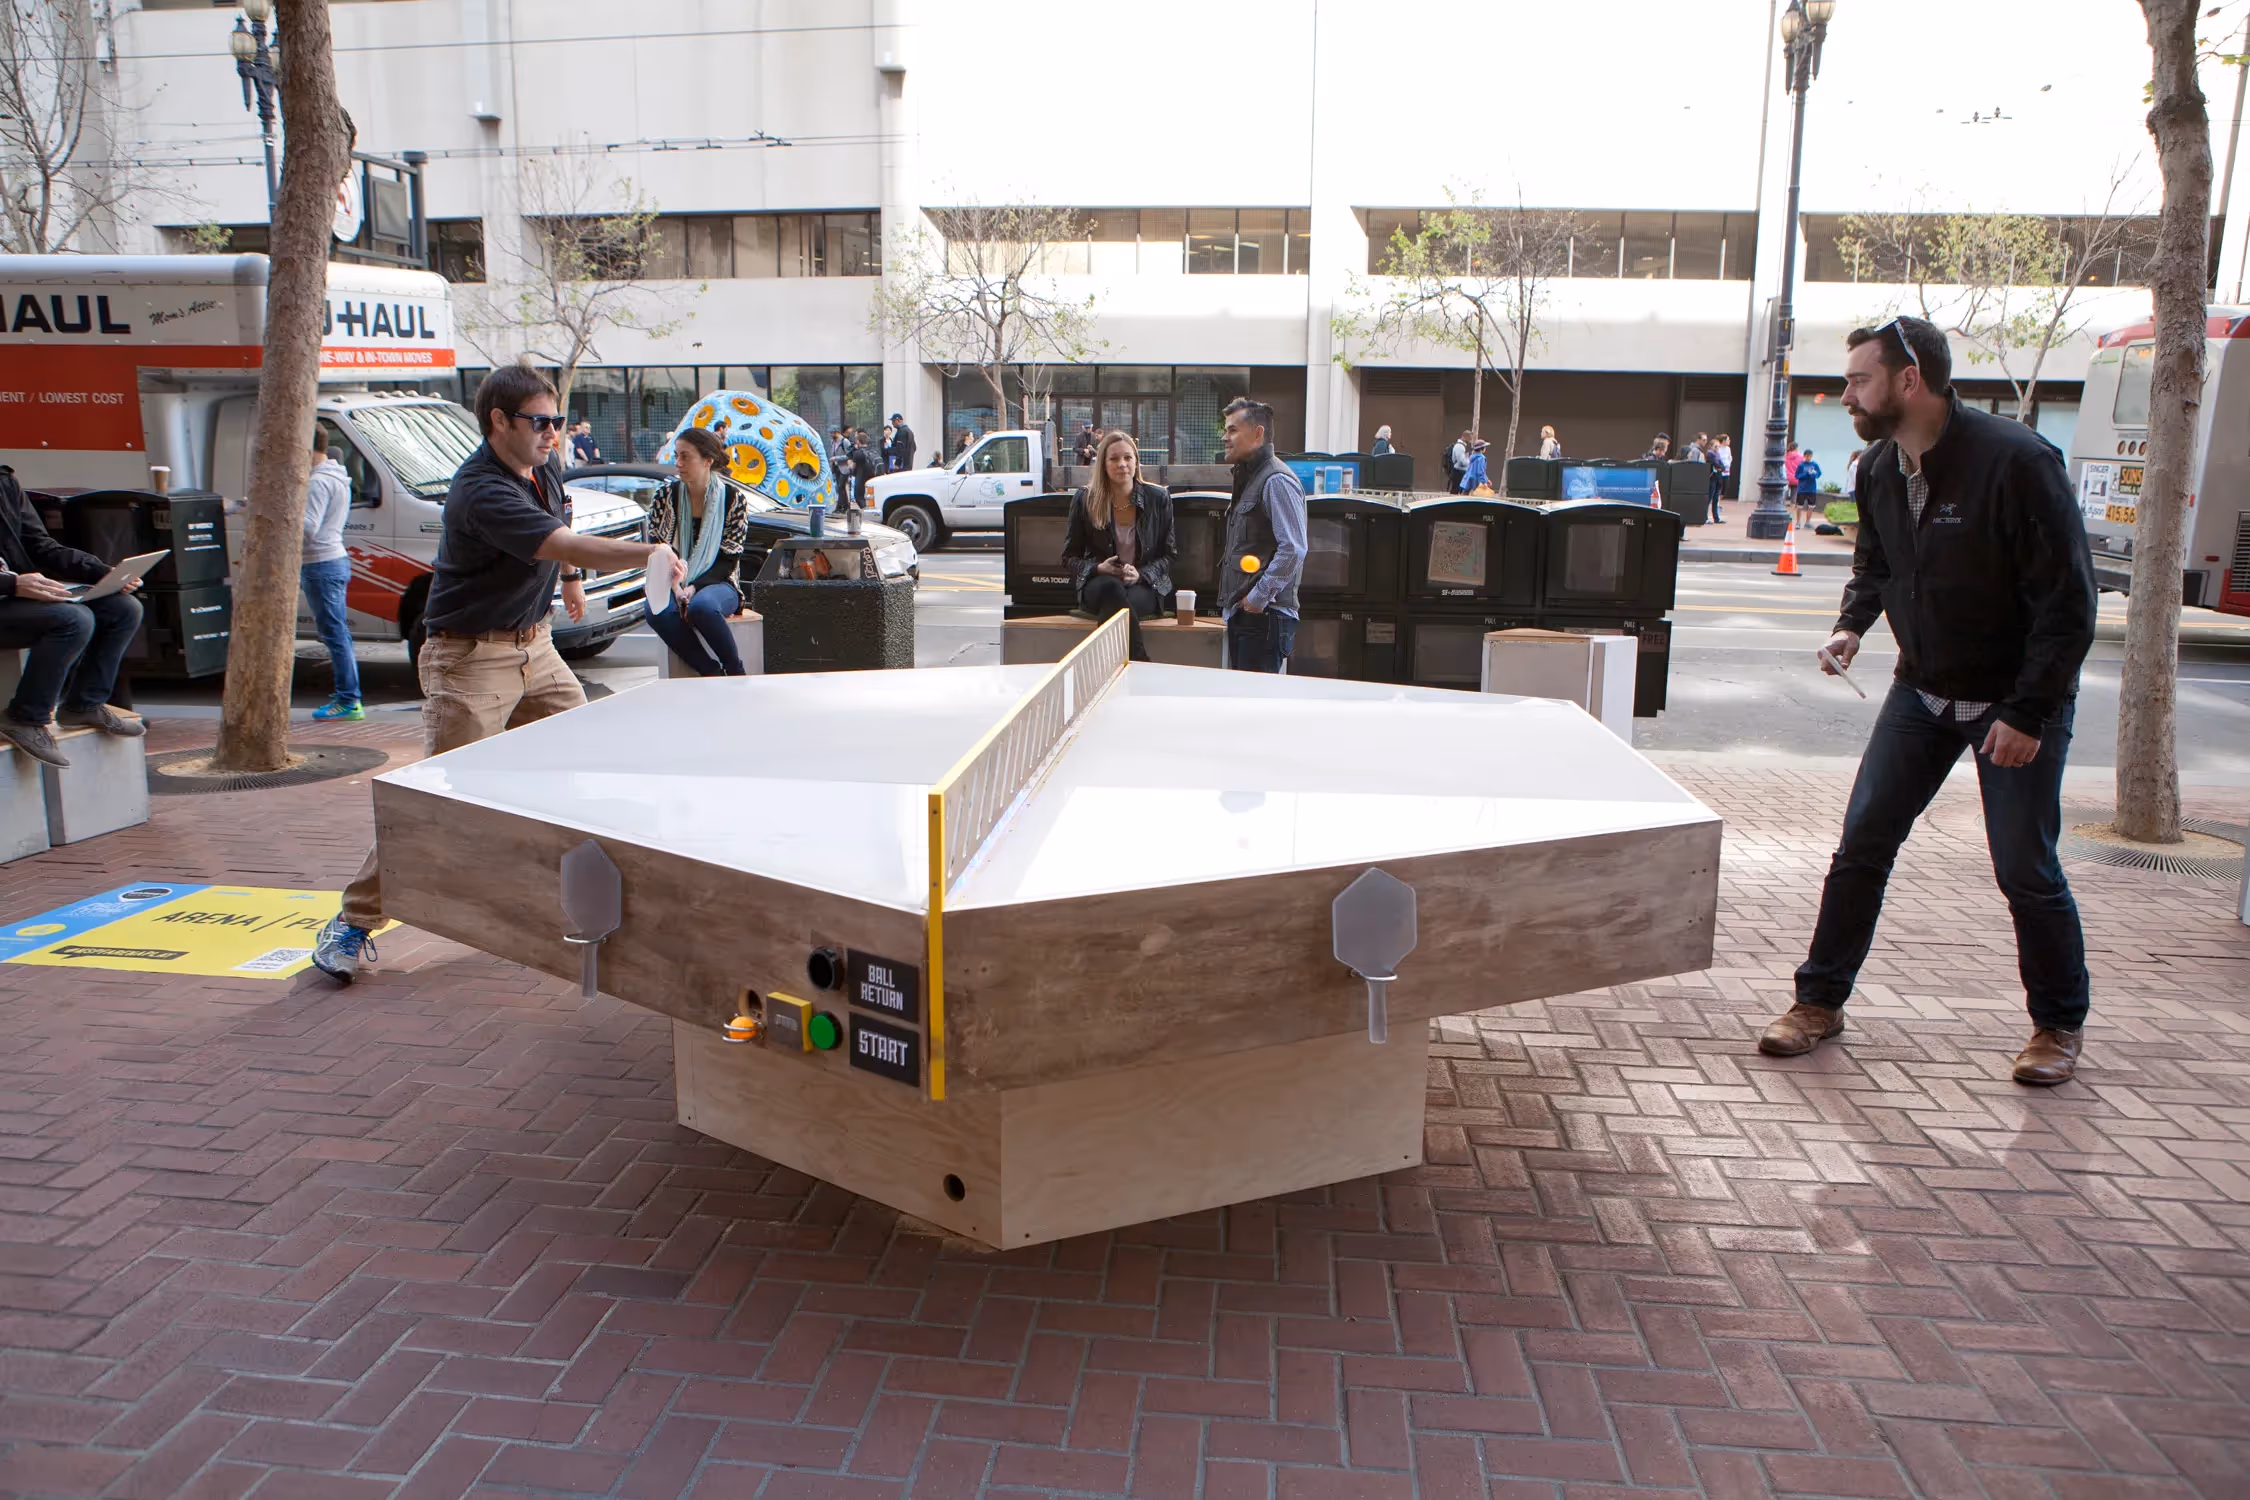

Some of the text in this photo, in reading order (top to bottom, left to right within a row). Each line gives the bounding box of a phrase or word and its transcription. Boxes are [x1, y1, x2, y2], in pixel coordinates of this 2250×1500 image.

[319, 350, 354, 363] NE-WAY
[0, 391, 26, 403] ENT
[39, 392, 89, 404] LOWEST
[91, 392, 125, 405] COST
[2121, 467, 2144, 483] SUNS
[152, 911, 263, 928] ARENA
[283, 917, 327, 931] PL
[867, 964, 896, 989] BALL
[860, 981, 904, 1011] RETURN
[858, 1028, 908, 1067] START
